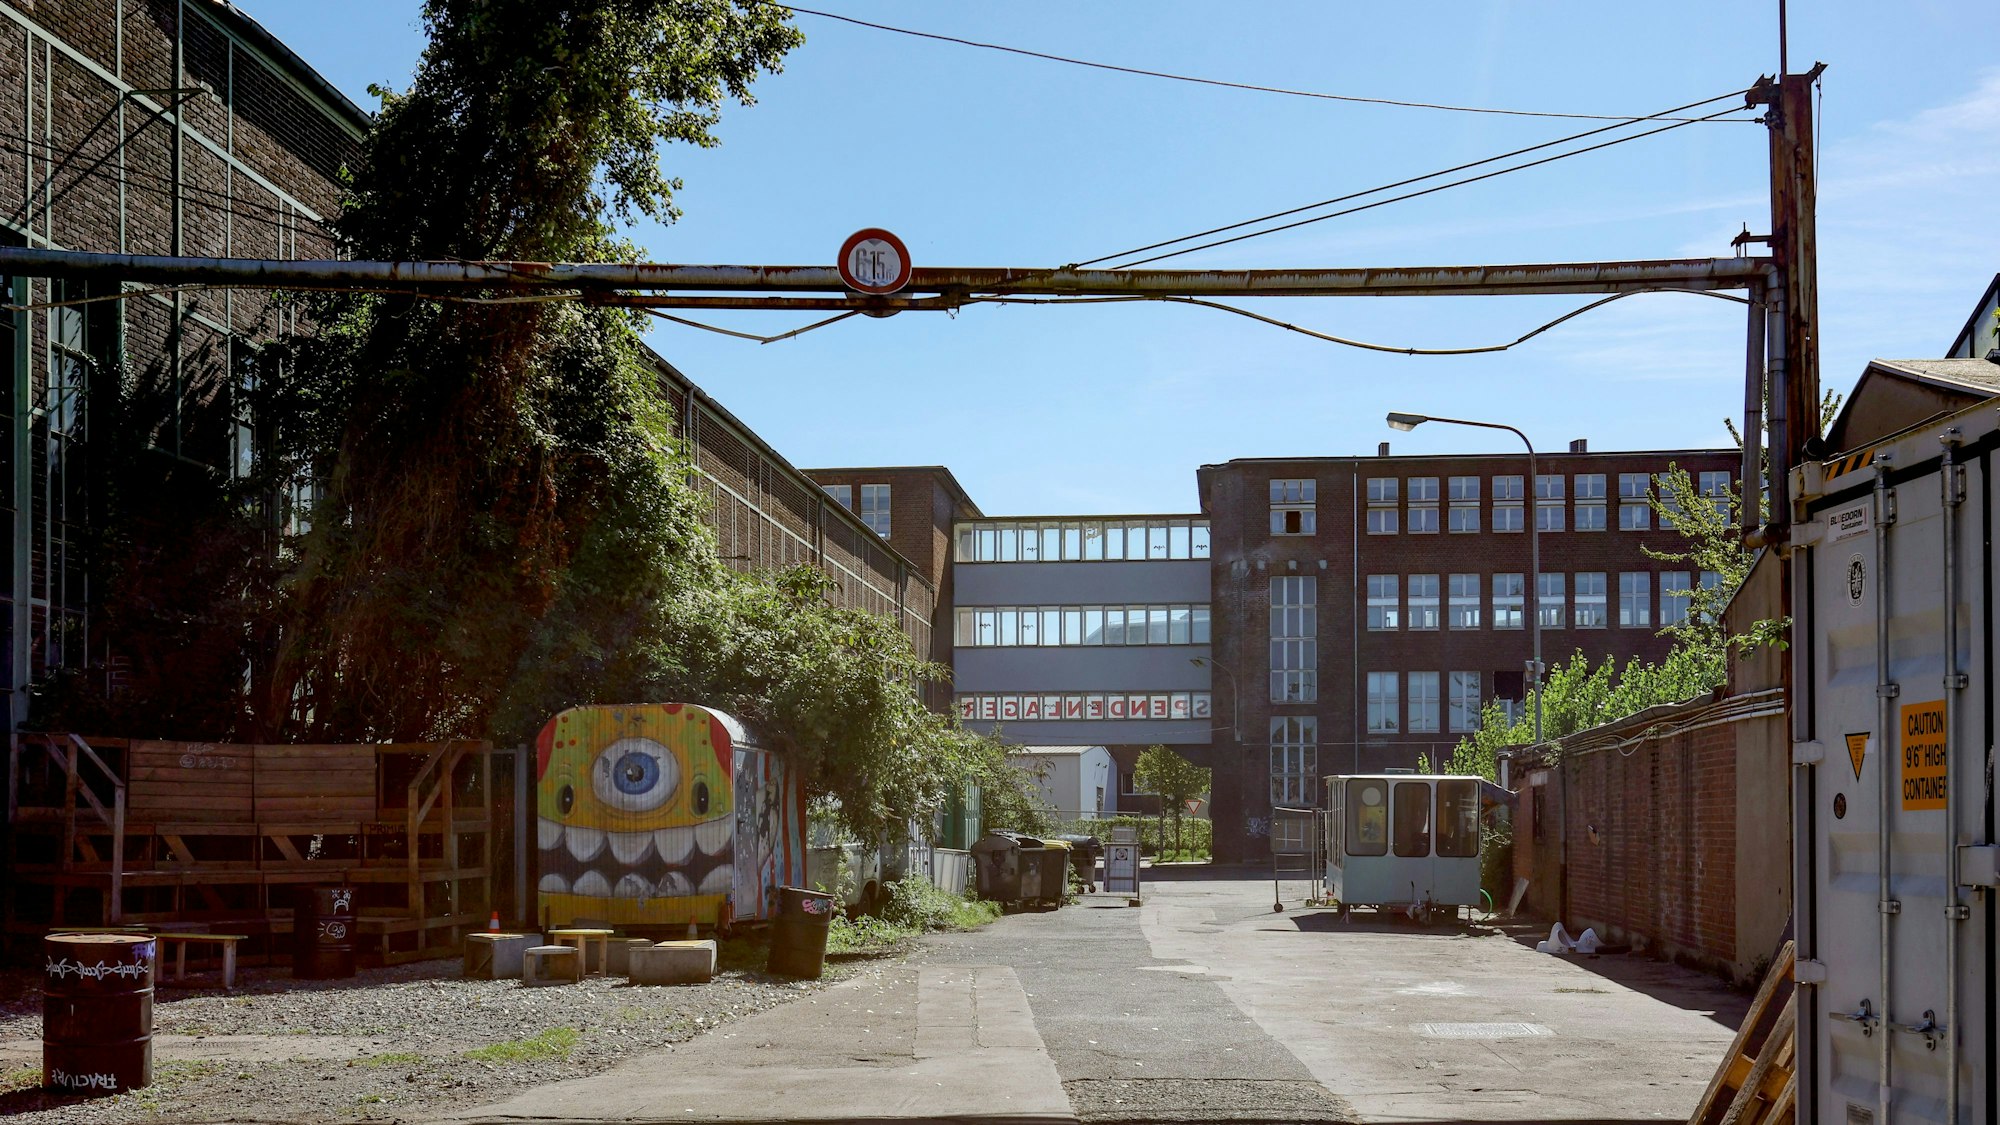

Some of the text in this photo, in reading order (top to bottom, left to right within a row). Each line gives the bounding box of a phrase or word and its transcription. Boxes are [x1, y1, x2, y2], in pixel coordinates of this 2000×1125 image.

[1830, 509, 1863, 526] BLOEDORN
[1841, 520, 1863, 530] Container
[1908, 711, 1944, 736] CAUTION
[1925, 743, 1947, 767] HIGH
[52, 1068, 118, 1090] FRACTURE
